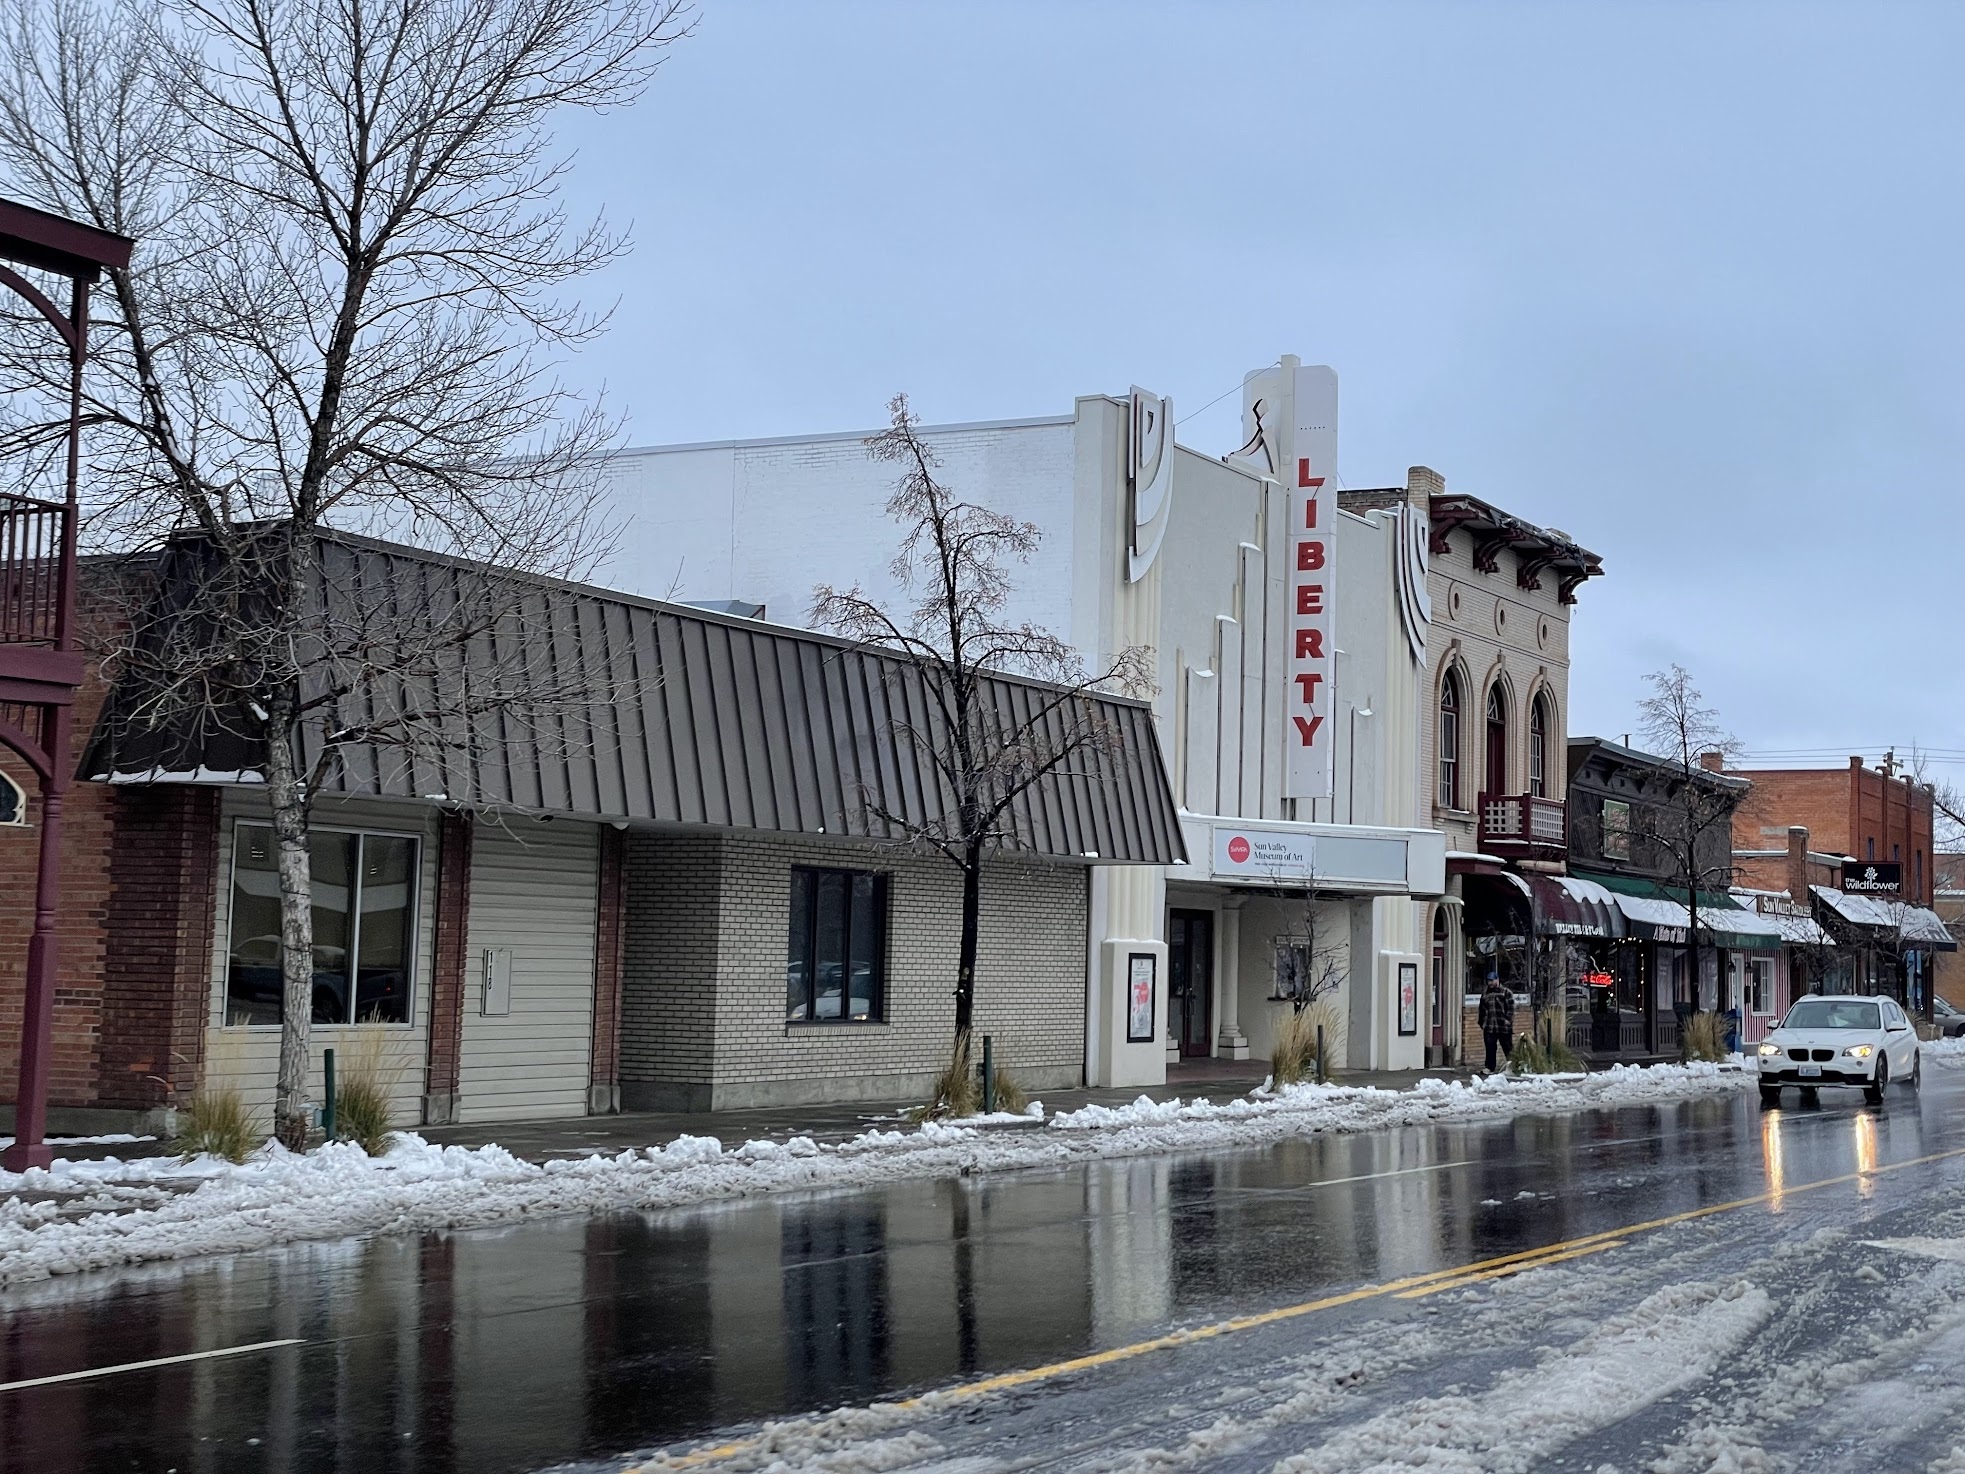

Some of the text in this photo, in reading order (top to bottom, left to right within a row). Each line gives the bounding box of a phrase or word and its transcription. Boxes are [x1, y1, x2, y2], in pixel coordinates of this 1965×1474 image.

[1292, 458, 1326, 747] LIBERTY
[1254, 842, 1287, 853] Sun Valley
[1254, 851, 1303, 861] Museum of Art
[1845, 880, 1899, 890] wildflower
